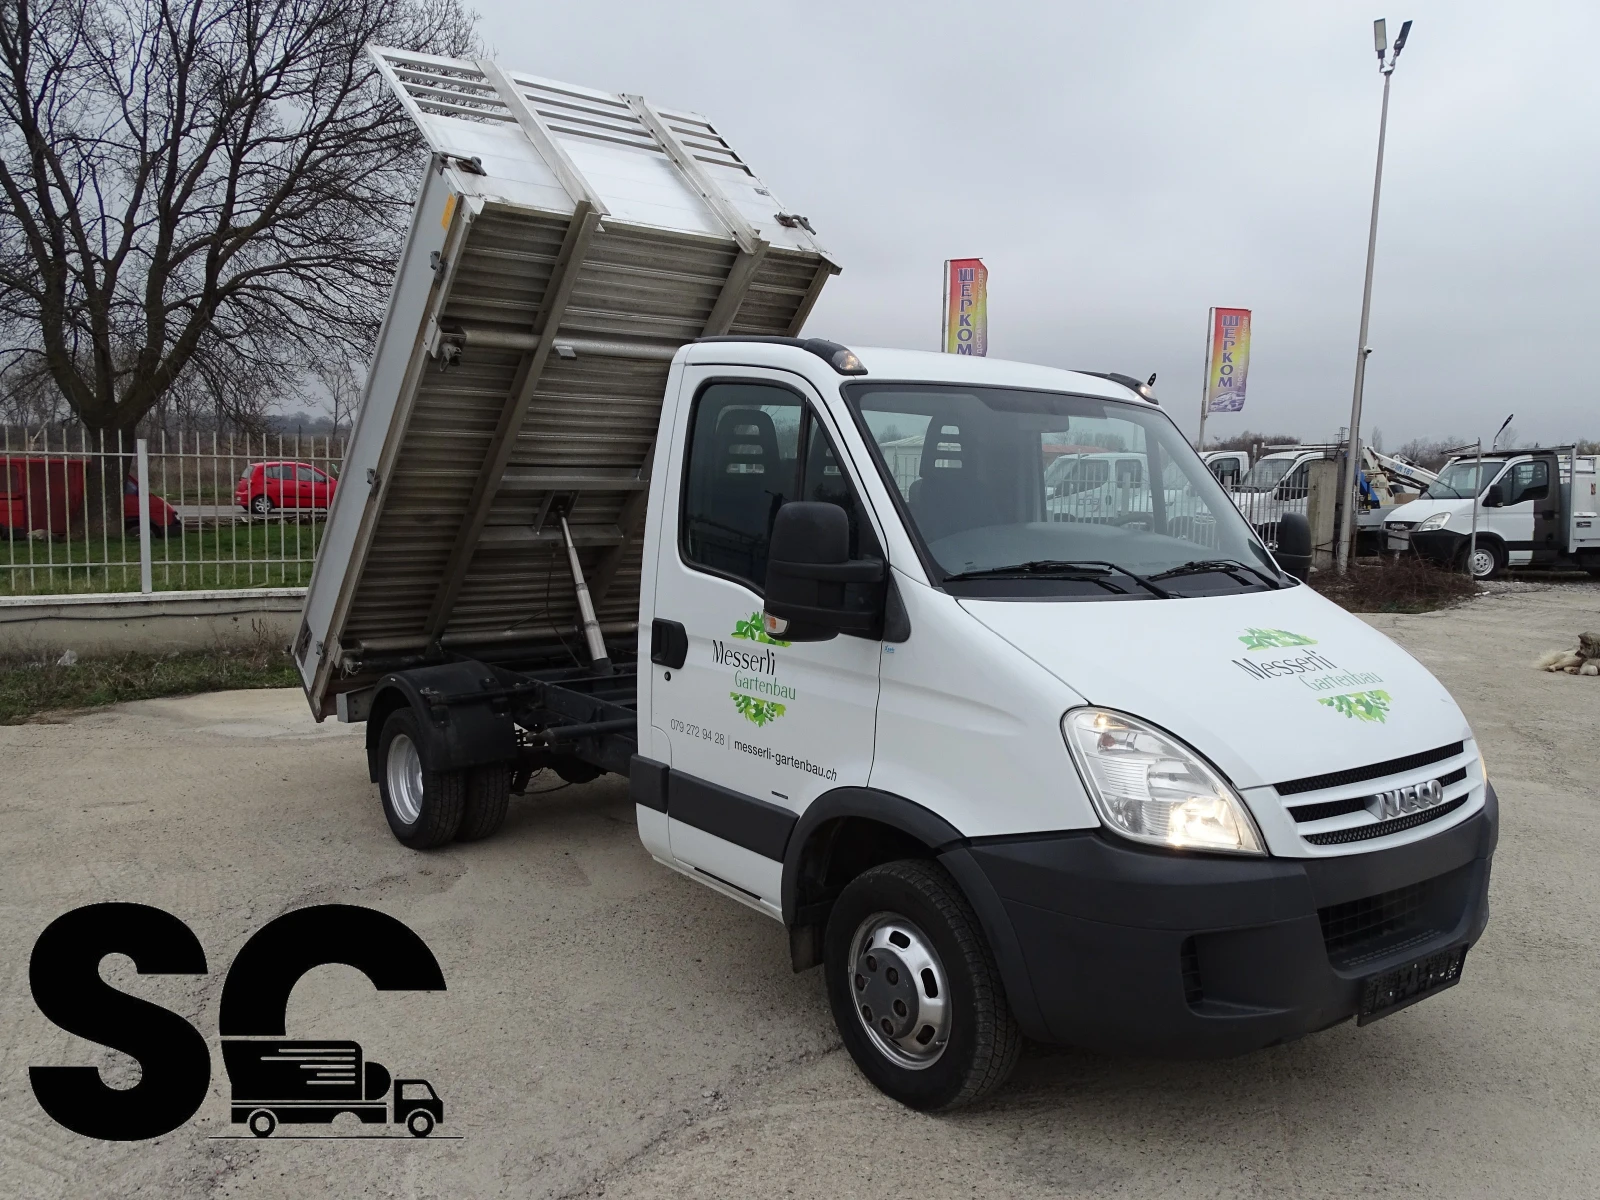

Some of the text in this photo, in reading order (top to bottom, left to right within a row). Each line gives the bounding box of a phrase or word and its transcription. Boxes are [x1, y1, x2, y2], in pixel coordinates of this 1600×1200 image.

[957, 268, 975, 355] ШЕРКОМ
[1218, 315, 1240, 388] ШЕРКОМ
[712, 639, 775, 675] Messerli
[1231, 648, 1337, 681] Messerli
[734, 669, 796, 700] Gartenbau
[1298, 668, 1384, 691] Gartenbau
[670, 719, 837, 782] 079 272 94 28 messerli-gartenbau.ch
[1375, 779, 1444, 821] IVECO
